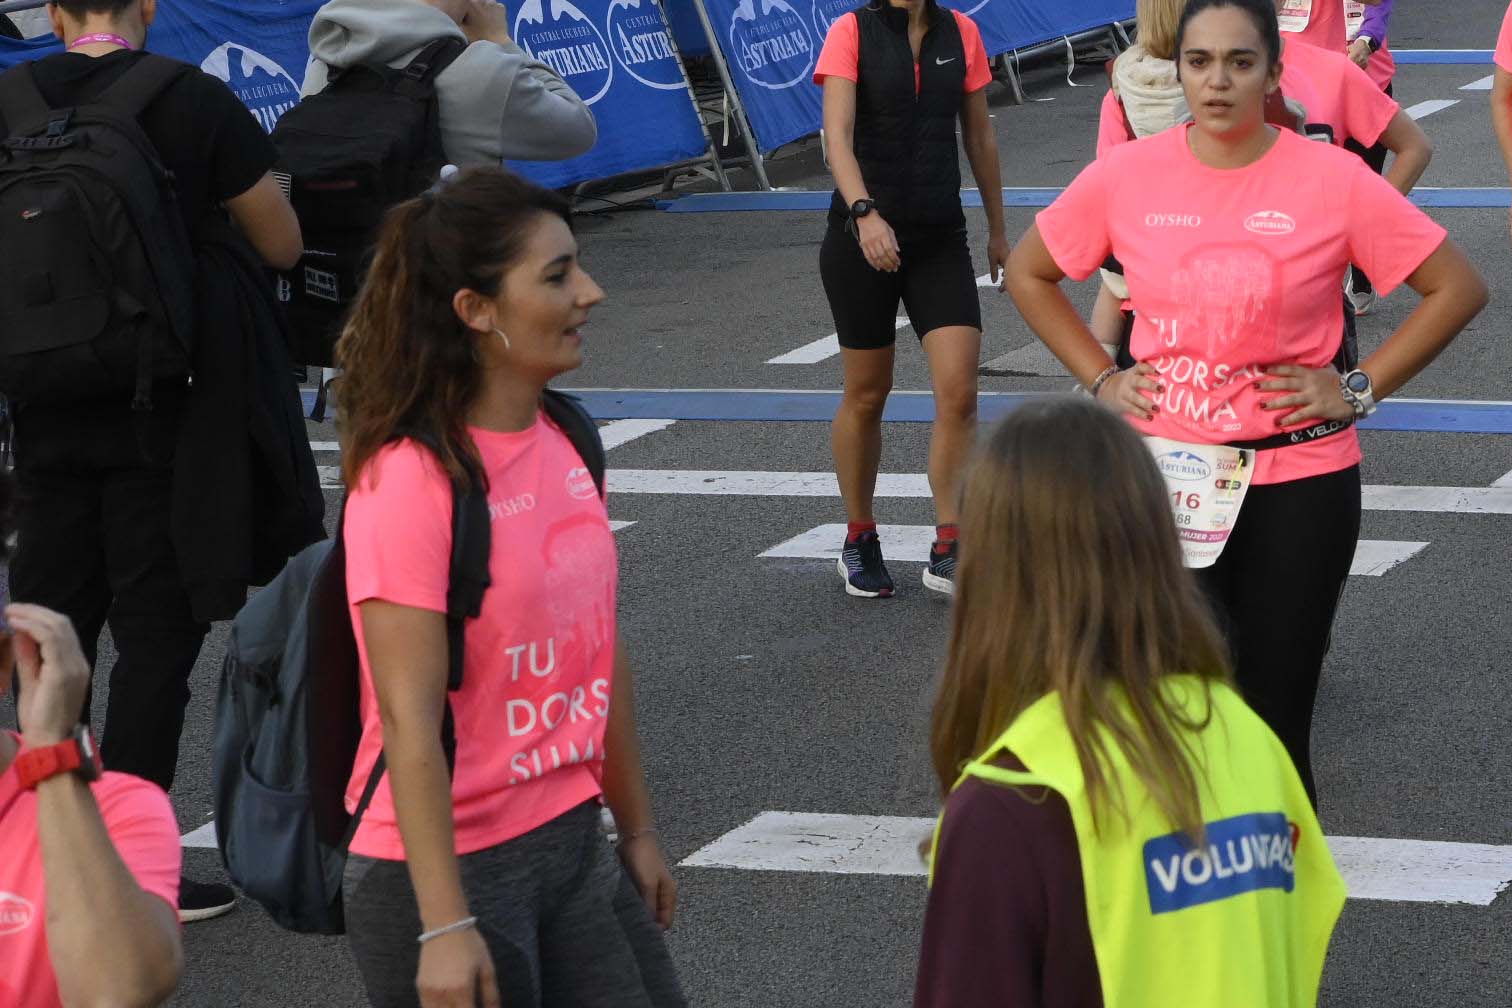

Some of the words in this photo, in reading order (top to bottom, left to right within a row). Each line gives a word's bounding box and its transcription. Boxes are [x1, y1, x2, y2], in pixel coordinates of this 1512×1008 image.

[1145, 213, 1201, 228] OYSHO
[1172, 490, 1201, 510] 16
[1175, 514, 1191, 525] 68
[505, 638, 555, 681] TU
